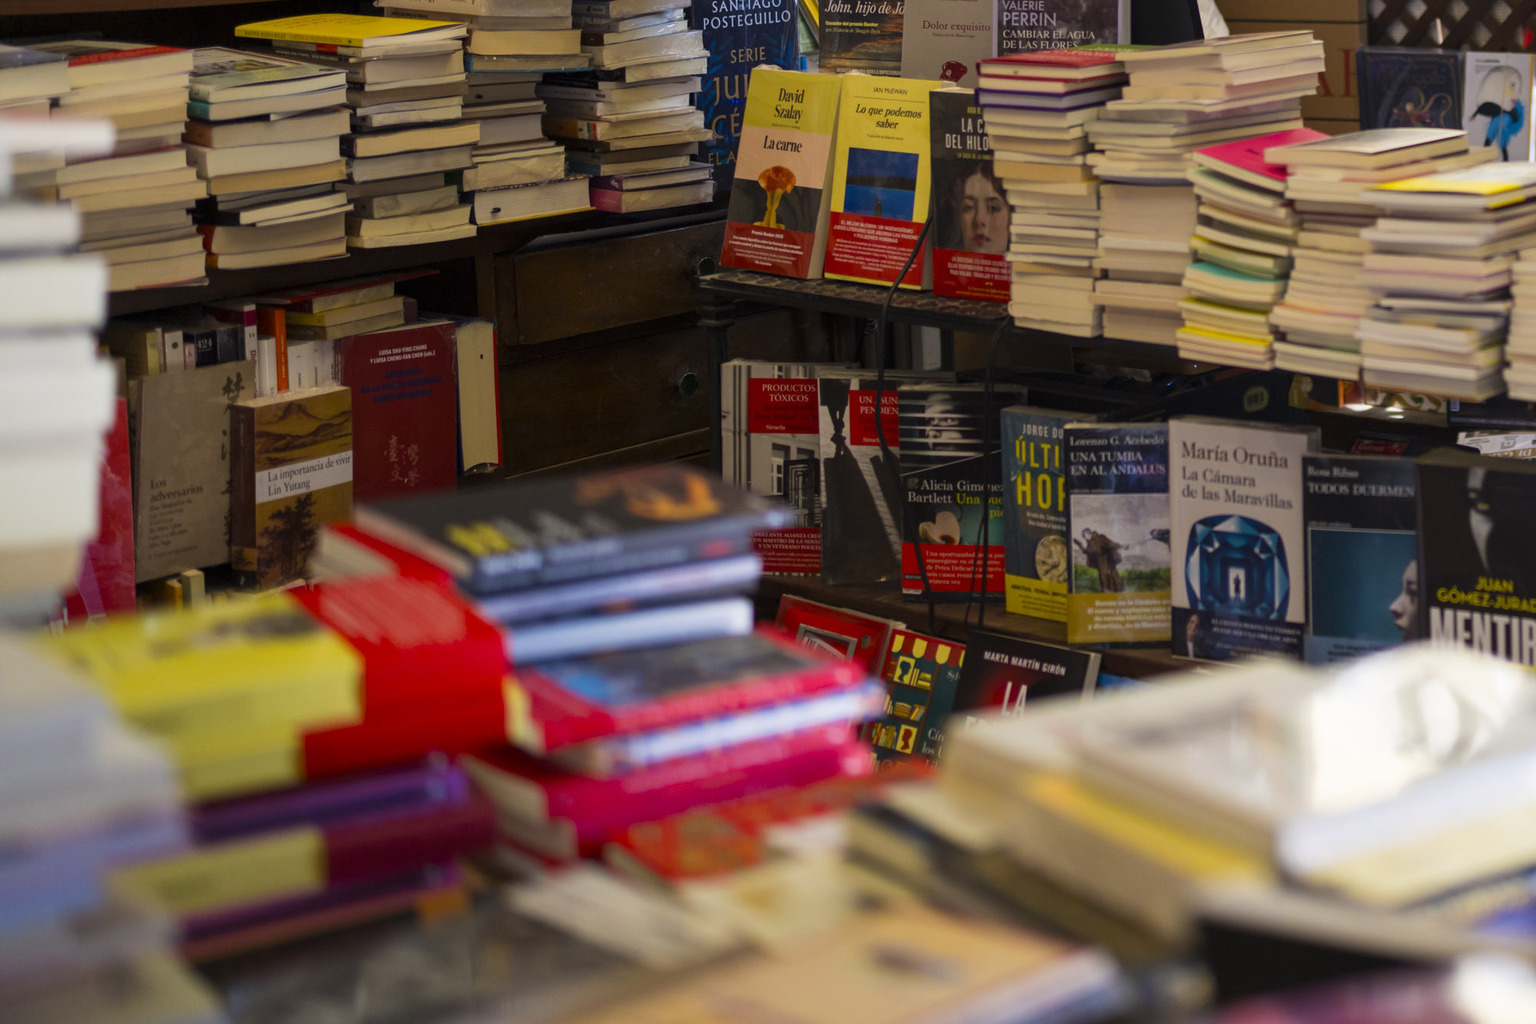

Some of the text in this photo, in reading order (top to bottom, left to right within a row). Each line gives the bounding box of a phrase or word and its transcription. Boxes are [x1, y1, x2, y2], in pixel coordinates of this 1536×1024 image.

[703, 10, 791, 30] POSTEGUILLO
[922, 20, 991, 33] Dolor exquisito
[1002, 12, 1057, 27] PERRIN
[1002, 29, 1095, 40] CAMBIAR EL AGUA
[730, 47, 767, 64] SERIE
[778, 88, 805, 104] David
[773, 104, 803, 124] Szalay
[876, 119, 898, 130] saber
[763, 135, 803, 153] La carne
[769, 392, 809, 402] TÓXICOS
[1181, 441, 1289, 469] María Oruña
[267, 454, 351, 483] La importancia de vivir
[921, 479, 953, 492] Alicia
[1182, 467, 1256, 488] La Cámara
[267, 480, 311, 497] Lin Yutang
[1307, 482, 1415, 497] TODOS DUERMEN
[1182, 484, 1294, 510] de las Maravillas
[1475, 577, 1514, 593] JUAN
